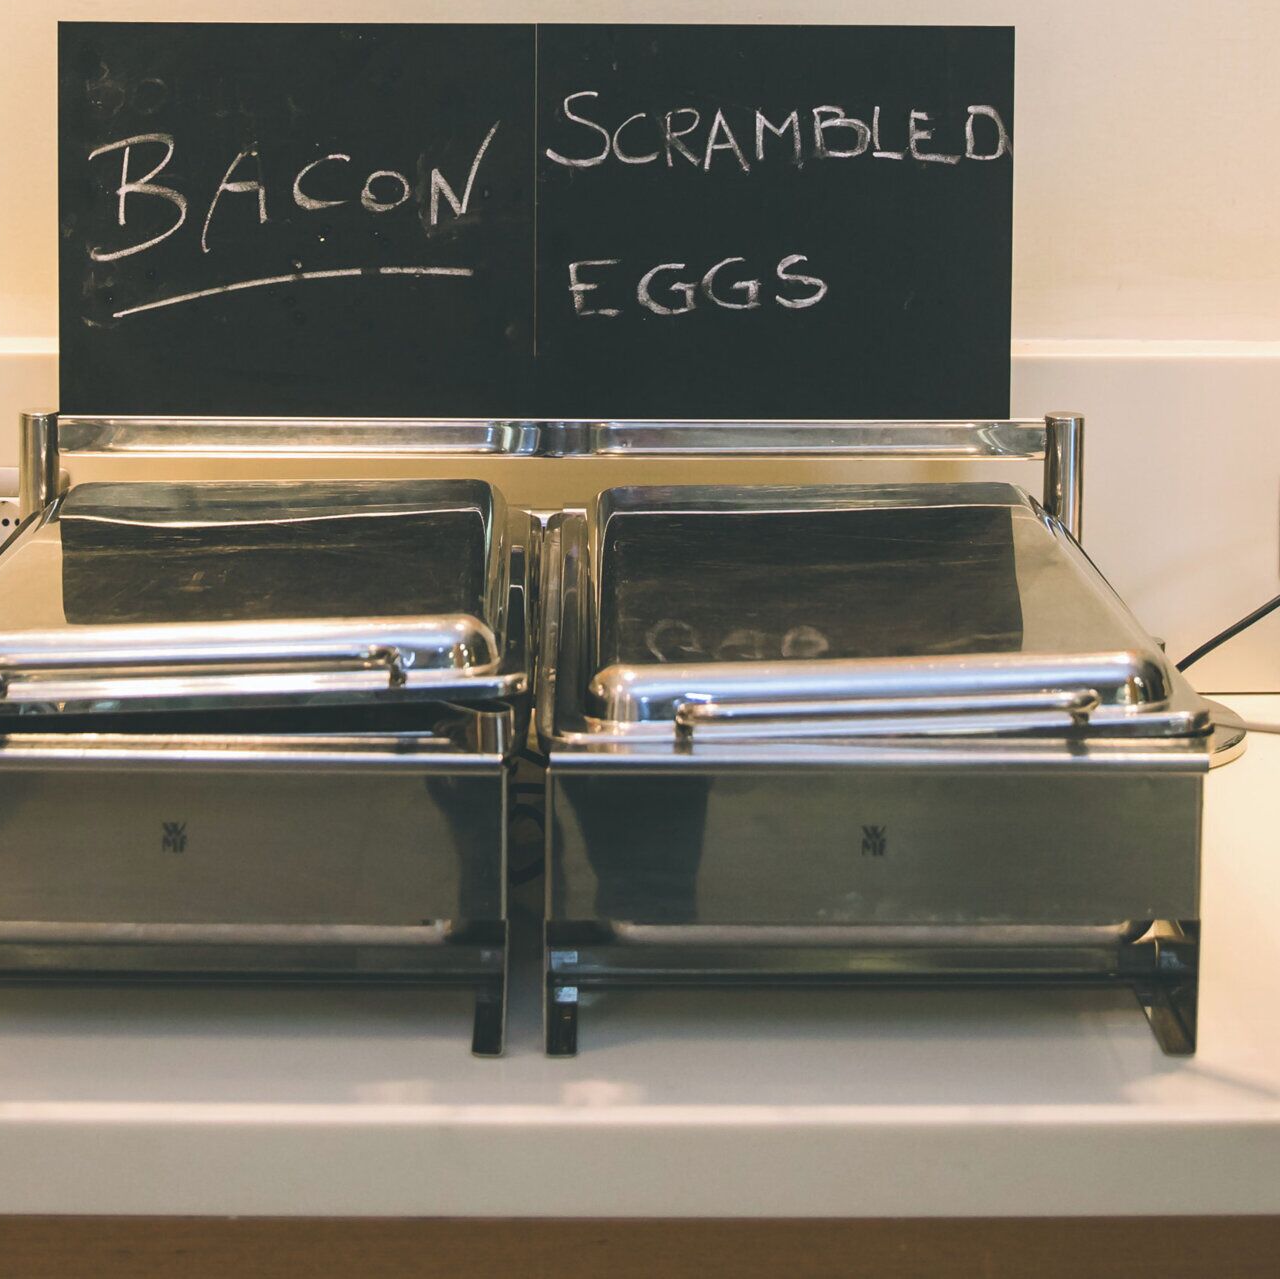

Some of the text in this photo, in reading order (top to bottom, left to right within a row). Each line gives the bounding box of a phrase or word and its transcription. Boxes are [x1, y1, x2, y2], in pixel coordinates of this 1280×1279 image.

[545, 91, 1014, 175] SCRAMBLED
[87, 120, 501, 262] BACON
[568, 254, 829, 317] EGGS
